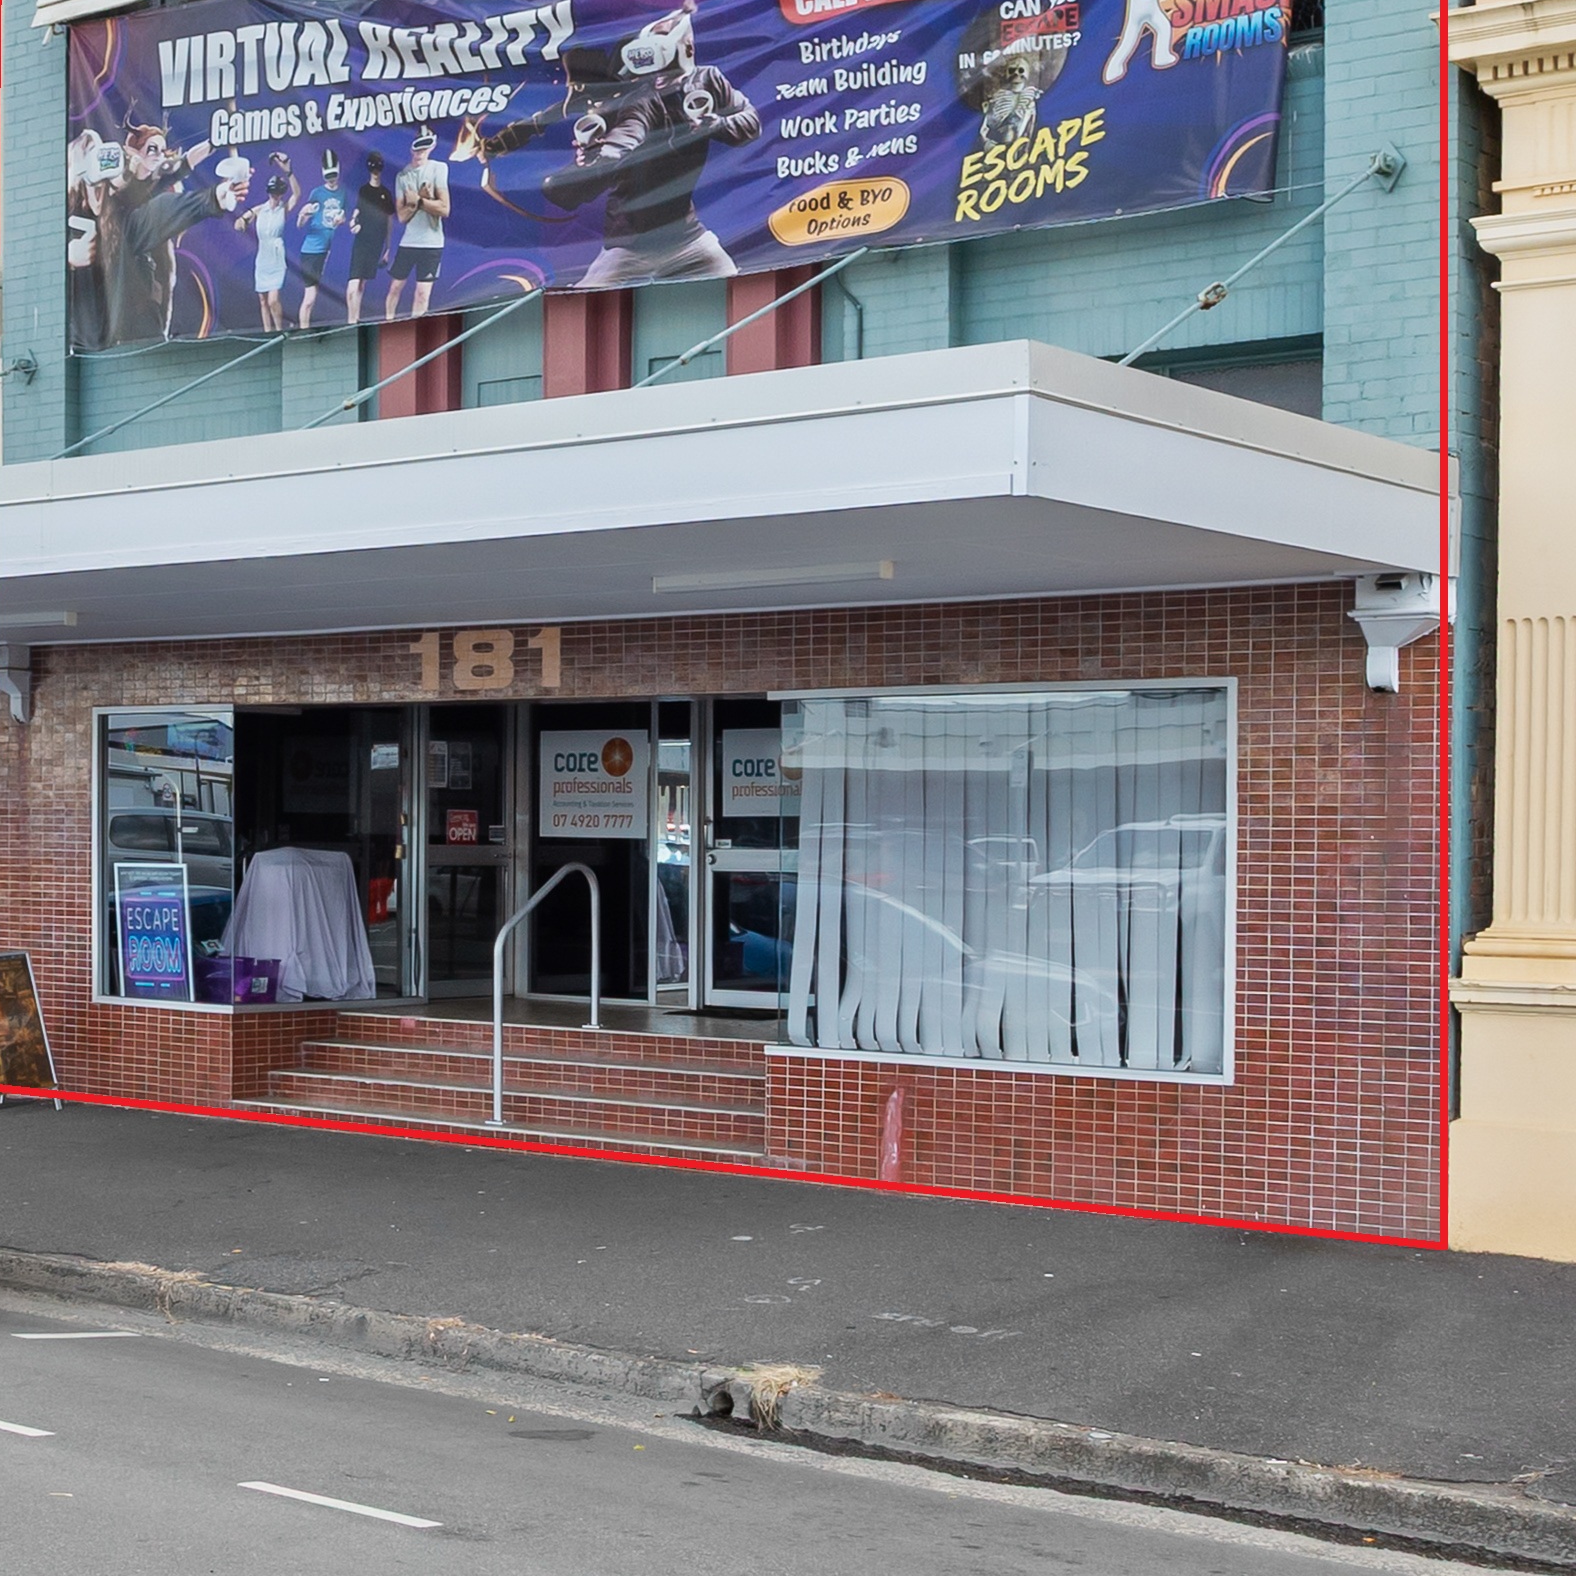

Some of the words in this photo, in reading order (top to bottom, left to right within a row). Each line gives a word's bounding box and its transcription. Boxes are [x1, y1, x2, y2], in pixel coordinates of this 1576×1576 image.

[799, 30, 902, 65] Birthdays
[1183, 6, 1284, 60] ROOMS
[159, 18, 350, 108] VIRTUAL
[959, 52, 975, 69] IN
[1002, 32, 1081, 56] MINUTES?
[833, 59, 927, 92] Building
[211, 100, 302, 148] Games
[304, 99, 322, 132] &
[326, 83, 512, 132] Experiences
[780, 111, 838, 139] Work
[844, 99, 921, 130] Parties
[776, 151, 839, 178] Bucks
[844, 147, 863, 168] &
[960, 108, 1106, 188] ESCAPE
[837, 191, 853, 211] &
[860, 187, 893, 207] BYO
[955, 151, 1089, 222] ROOMS
[806, 213, 871, 236] Options
[409, 627, 561, 691] 181
[554, 752, 599, 773] core
[732, 758, 776, 777] core
[553, 777, 633, 797] professionals
[732, 781, 802, 800] professional
[448, 827, 477, 841] OPEN
[553, 814, 567, 827] 07
[570, 814, 600, 828] 4920
[603, 814, 633, 828] 7777
[127, 907, 179, 931] ESCAPE
[128, 935, 181, 973] ROOM
